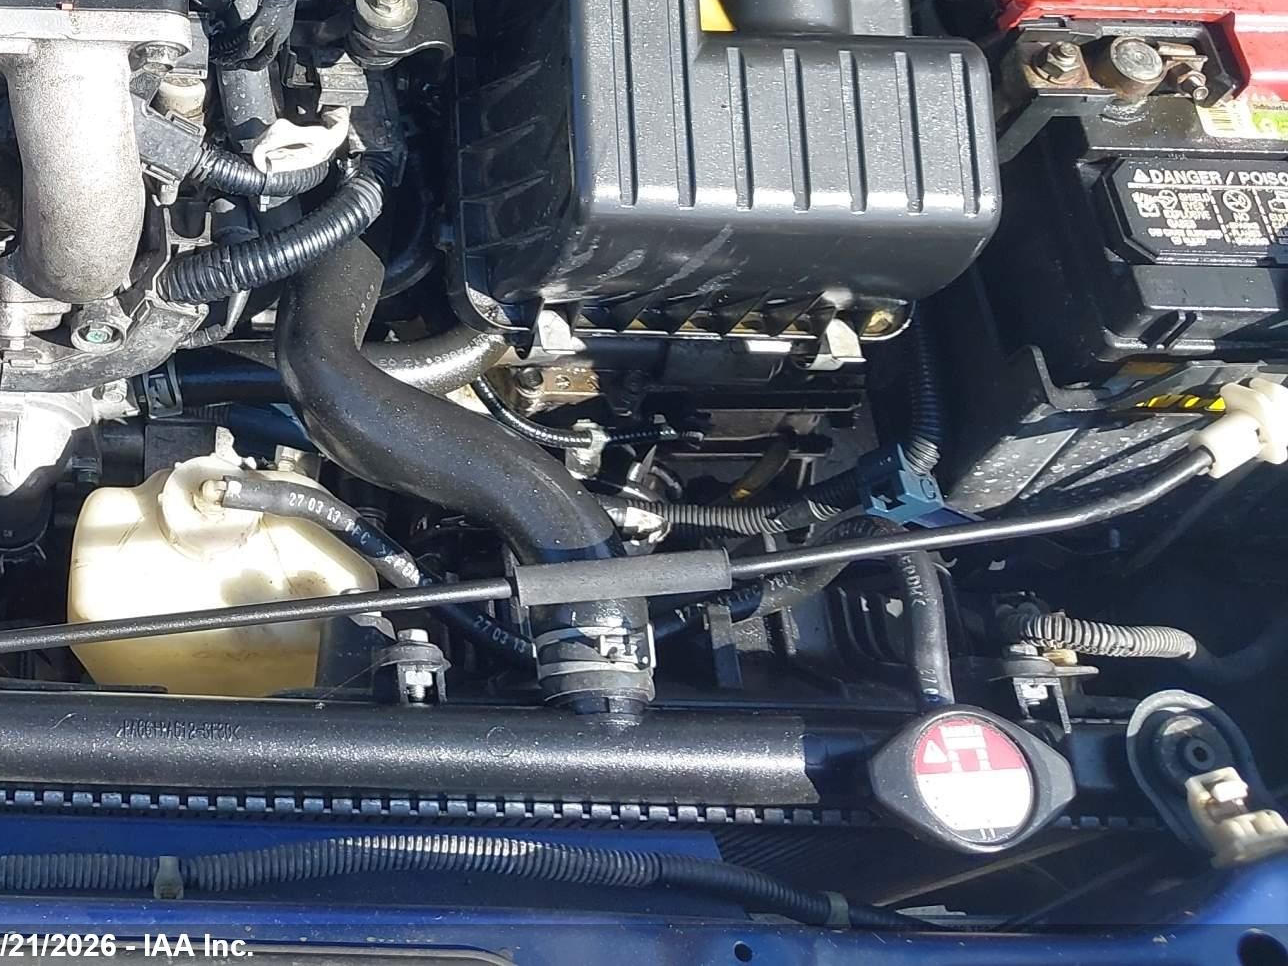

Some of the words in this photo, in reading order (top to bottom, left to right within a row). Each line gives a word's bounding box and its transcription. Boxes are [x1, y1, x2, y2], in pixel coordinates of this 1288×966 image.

[1149, 169, 1223, 184] DANGER
[1178, 192, 1211, 202] SHIELD
[288, 492, 304, 508] 27
[307, 497, 324, 515] 03
[473, 614, 491, 631] 27
[492, 627, 508, 643] 03
